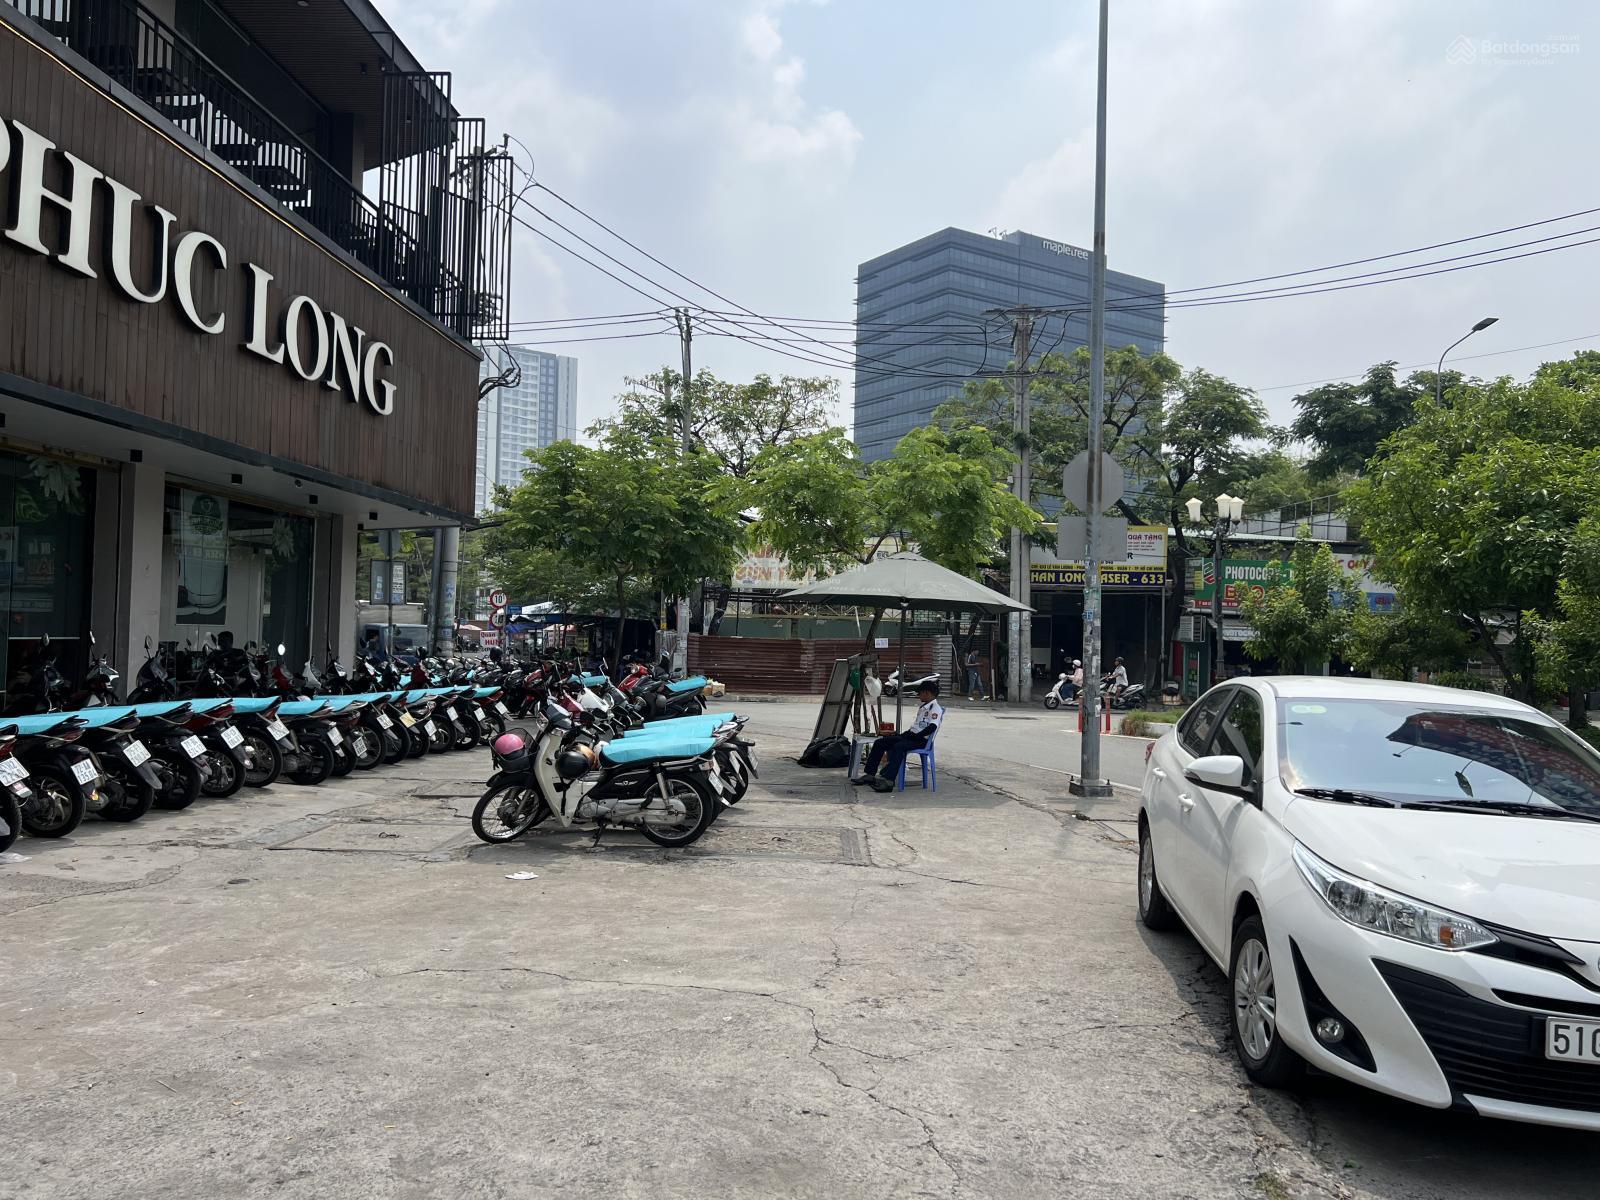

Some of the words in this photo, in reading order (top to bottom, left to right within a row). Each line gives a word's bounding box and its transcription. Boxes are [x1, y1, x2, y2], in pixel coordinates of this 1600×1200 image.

[1042, 240, 1089, 260] mapletree
[246, 262, 397, 416] LONG
[1101, 573, 1130, 585] ASER
[1141, 574, 1164, 584] 633
